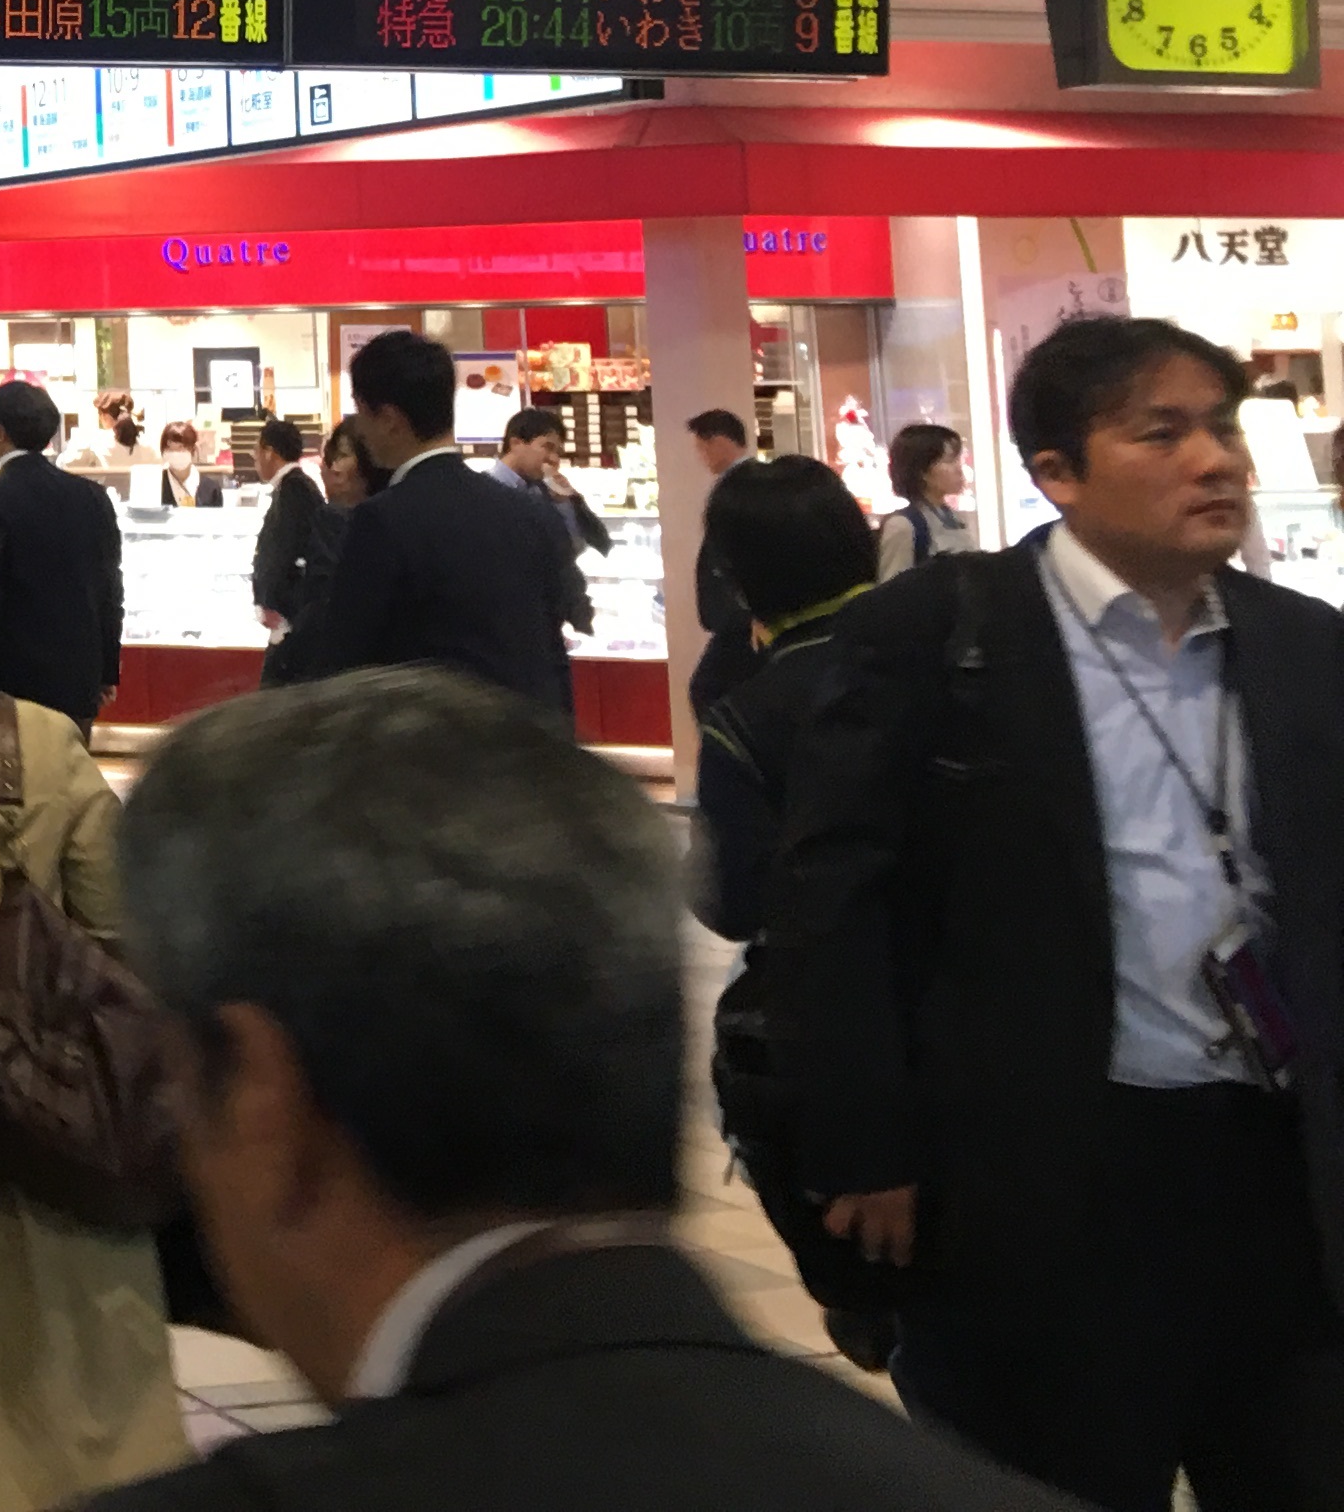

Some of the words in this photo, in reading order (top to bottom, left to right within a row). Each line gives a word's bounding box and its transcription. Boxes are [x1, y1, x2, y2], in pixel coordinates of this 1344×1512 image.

[377, 1, 458, 49] 特急
[480, 5, 593, 49] 20:44
[596, 7, 704, 52] いわき
[1248, 3, 1267, 26] 4
[1157, 25, 1175, 49] 7
[1189, 34, 1208, 58] 6
[1220, 27, 1239, 52] 5
[742, 228, 828, 253] uatre
[1172, 224, 1290, 266] 八天堂
[162, 237, 290, 272] Quatre
